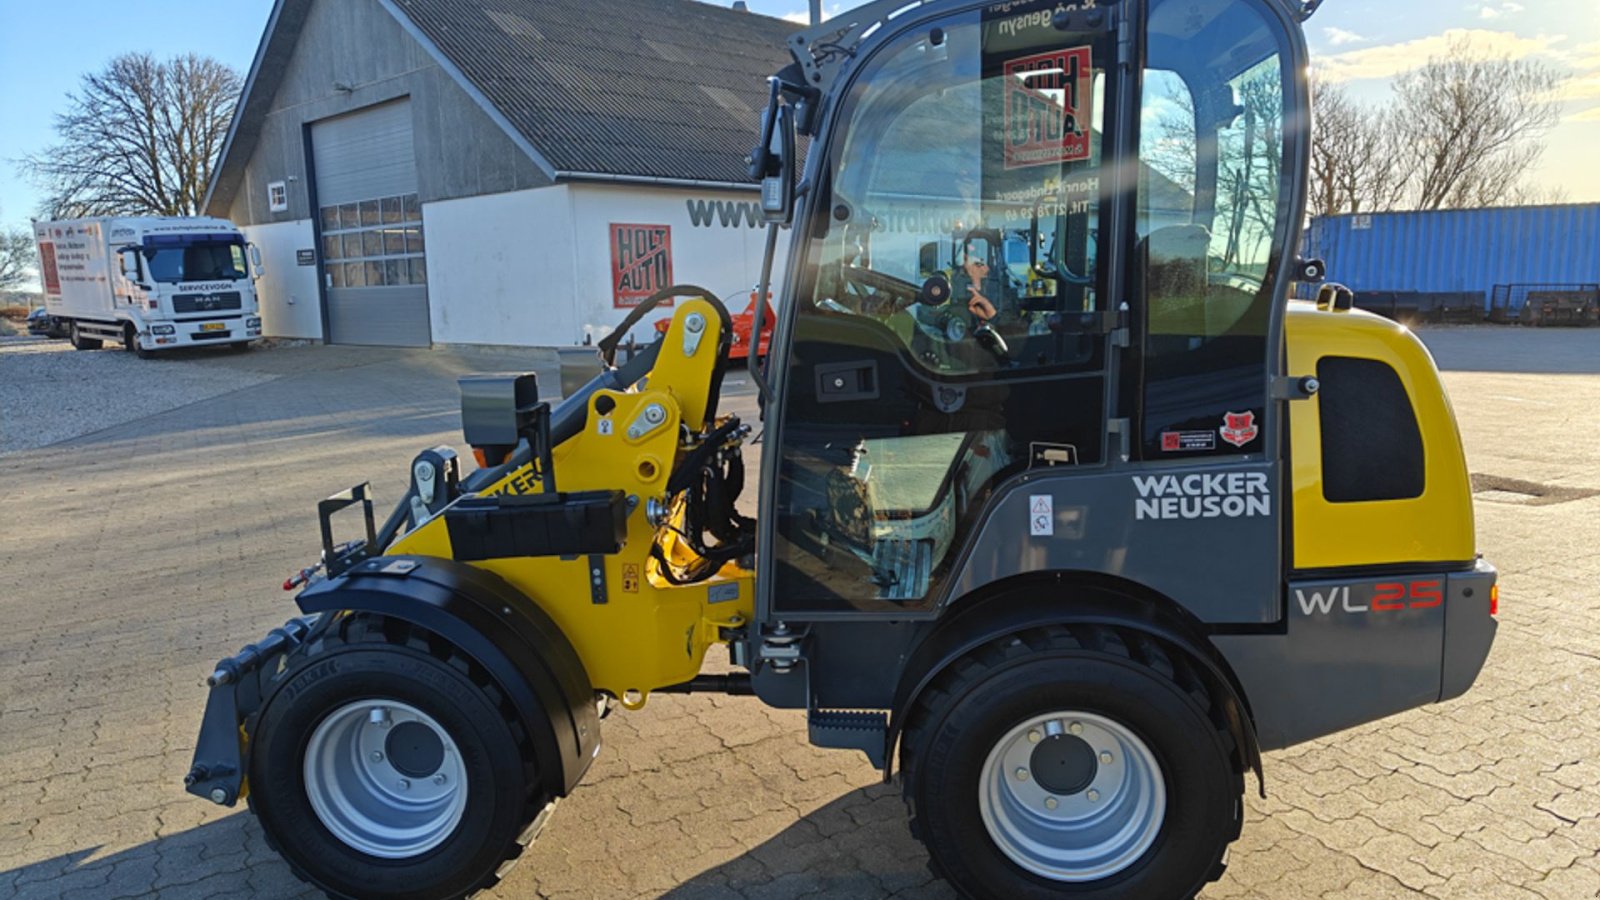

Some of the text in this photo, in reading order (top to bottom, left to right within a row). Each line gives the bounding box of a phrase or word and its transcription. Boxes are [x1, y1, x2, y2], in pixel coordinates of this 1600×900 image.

[618, 228, 666, 270] HOLT
[618, 249, 668, 290] AUTO
[179, 283, 233, 292] SERVICEVOGN
[1132, 472, 1270, 498] WACKER
[1135, 494, 1271, 520] NEUSON
[1294, 581, 1443, 615] WL25
